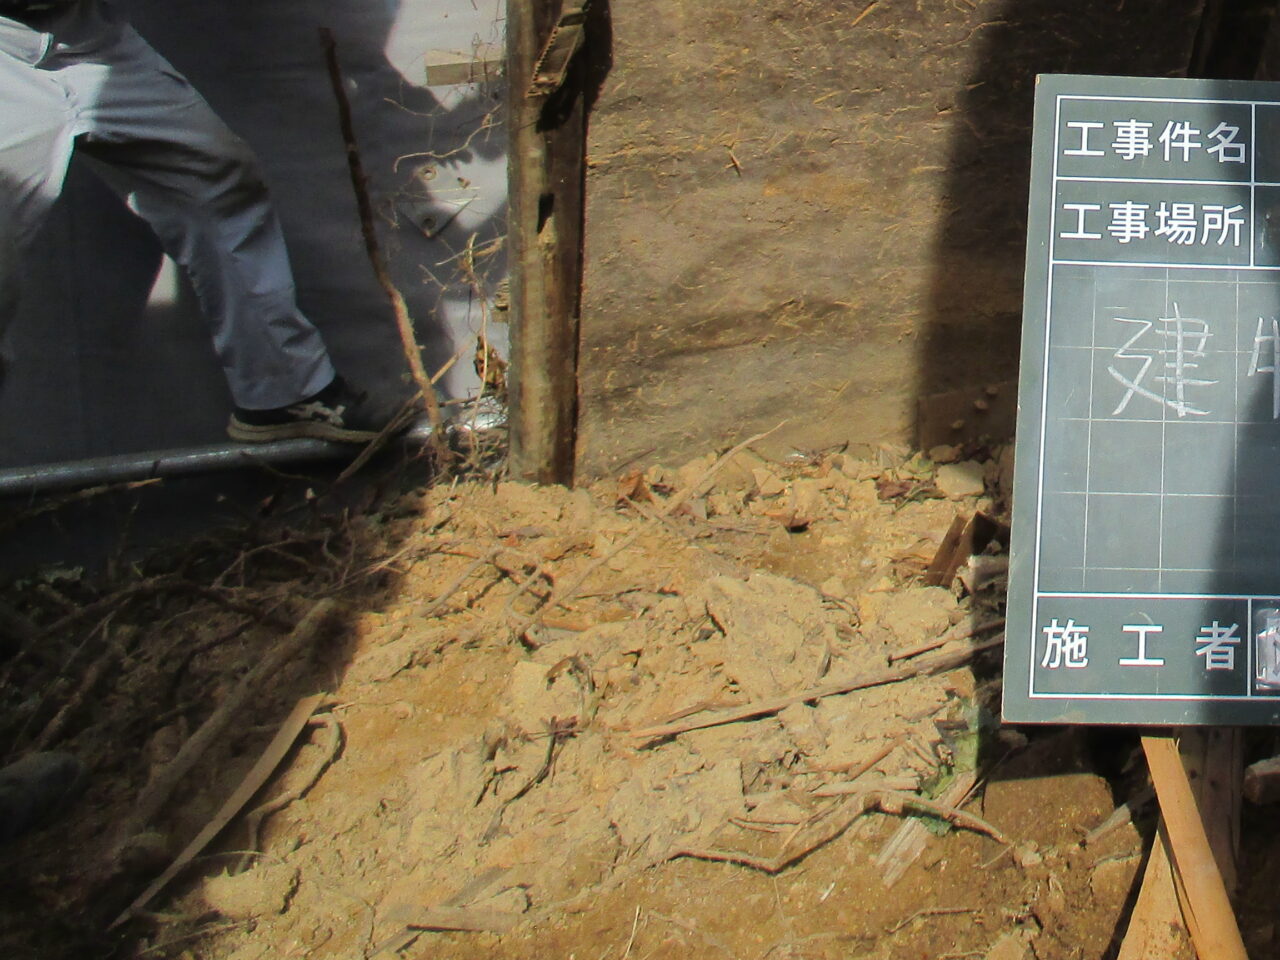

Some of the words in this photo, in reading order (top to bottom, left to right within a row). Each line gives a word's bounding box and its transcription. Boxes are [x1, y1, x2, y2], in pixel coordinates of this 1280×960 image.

[1062, 118, 1247, 164] 工事件名
[1059, 200, 1246, 248] 工事場所
[1041, 616, 1243, 672] 施工者
